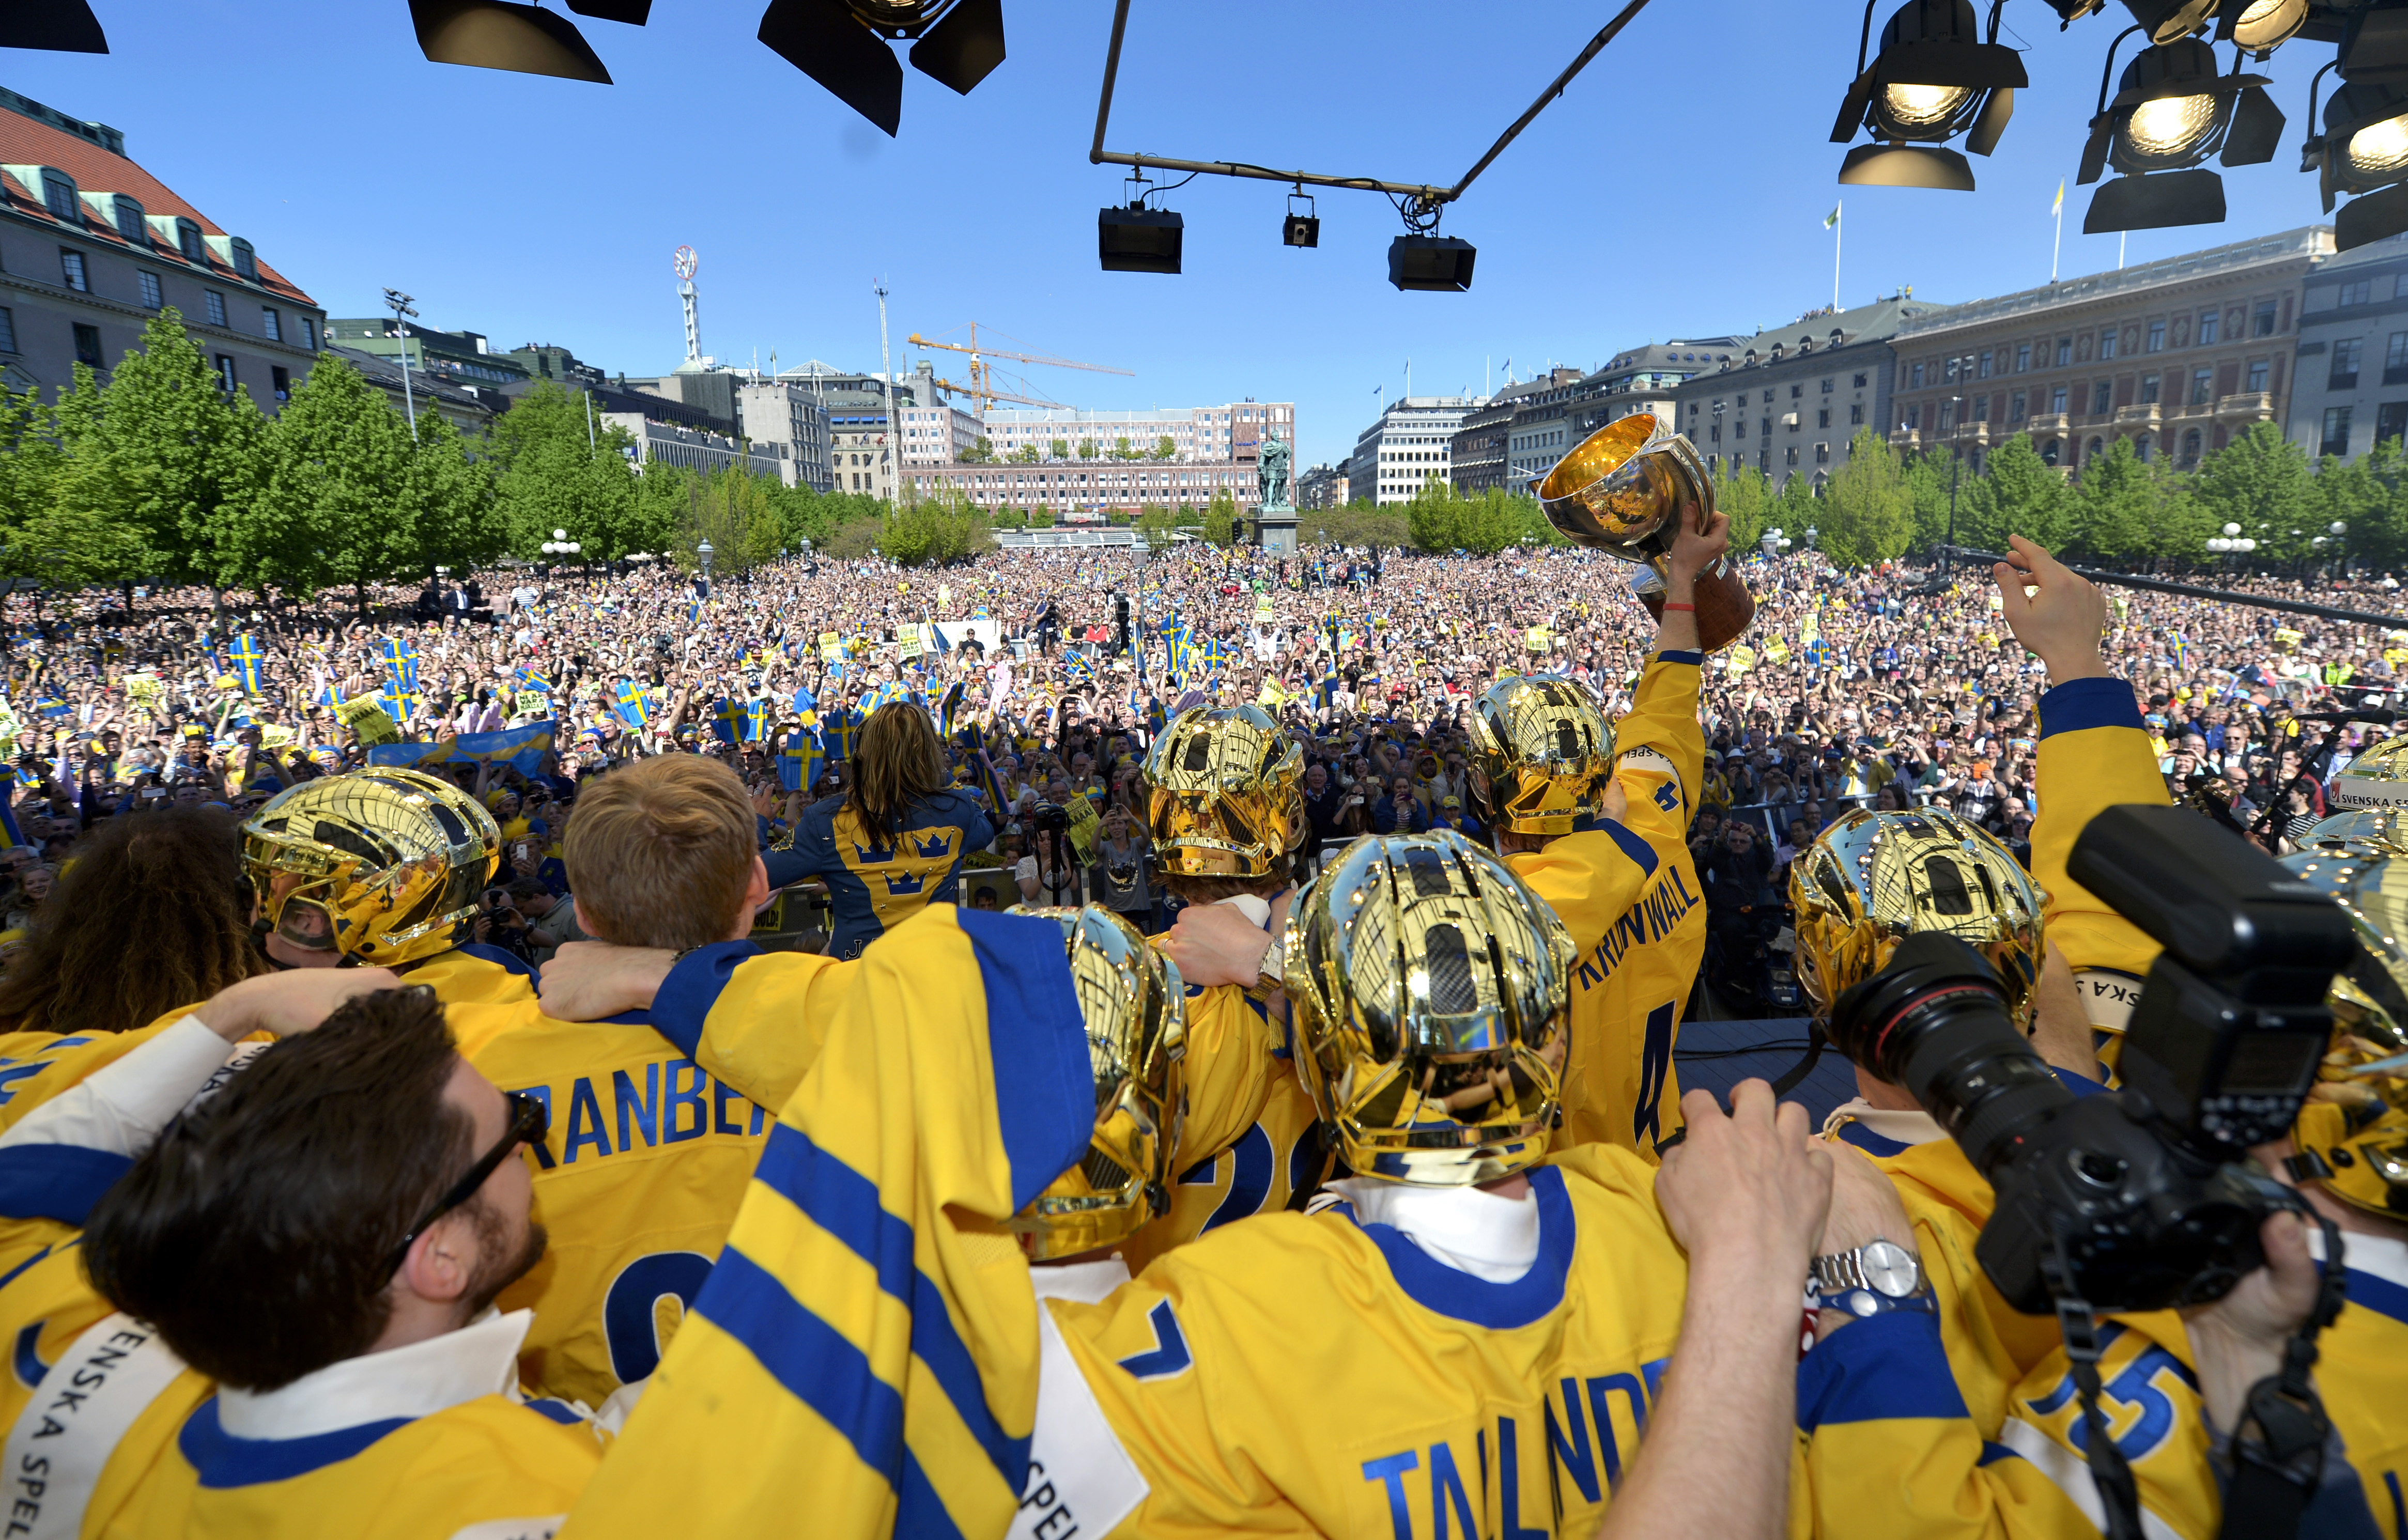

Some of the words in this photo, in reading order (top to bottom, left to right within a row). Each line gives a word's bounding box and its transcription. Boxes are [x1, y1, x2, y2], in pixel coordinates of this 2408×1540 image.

[1624, 749, 1654, 759] SPEL
[2342, 794, 2390, 807] SVENSKA
[4, 1452, 51, 1539] SPEL
